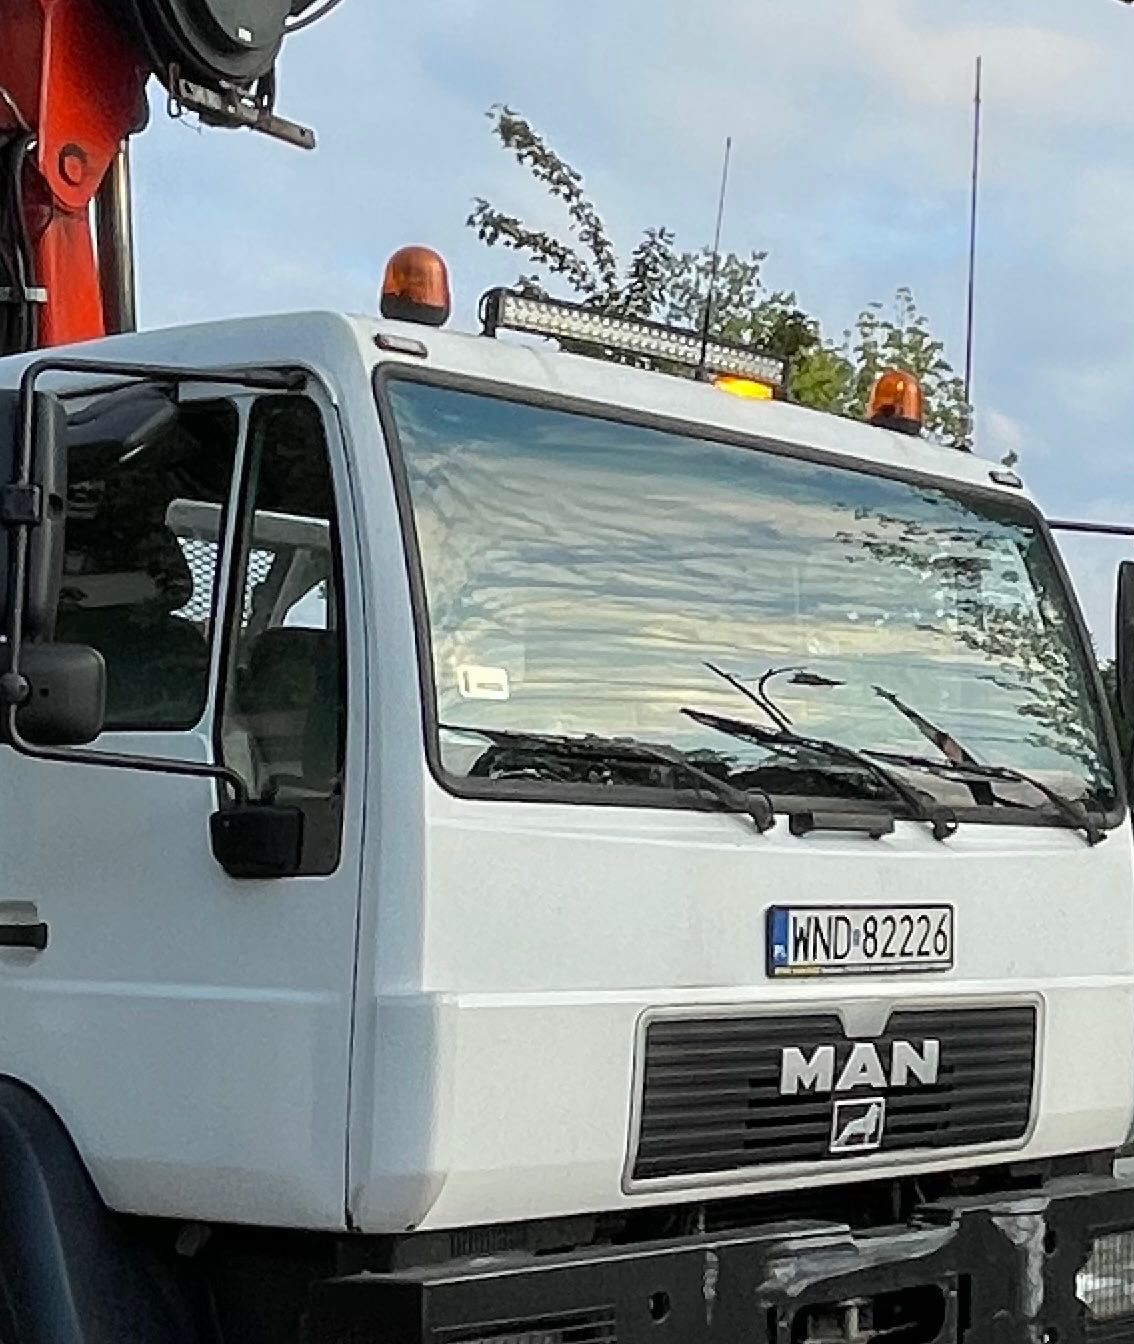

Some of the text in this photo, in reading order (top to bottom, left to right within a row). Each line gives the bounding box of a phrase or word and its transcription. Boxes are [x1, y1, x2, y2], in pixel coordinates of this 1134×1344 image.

[792, 913, 949, 962] WND 82226
[780, 1040, 940, 1095] MAN
